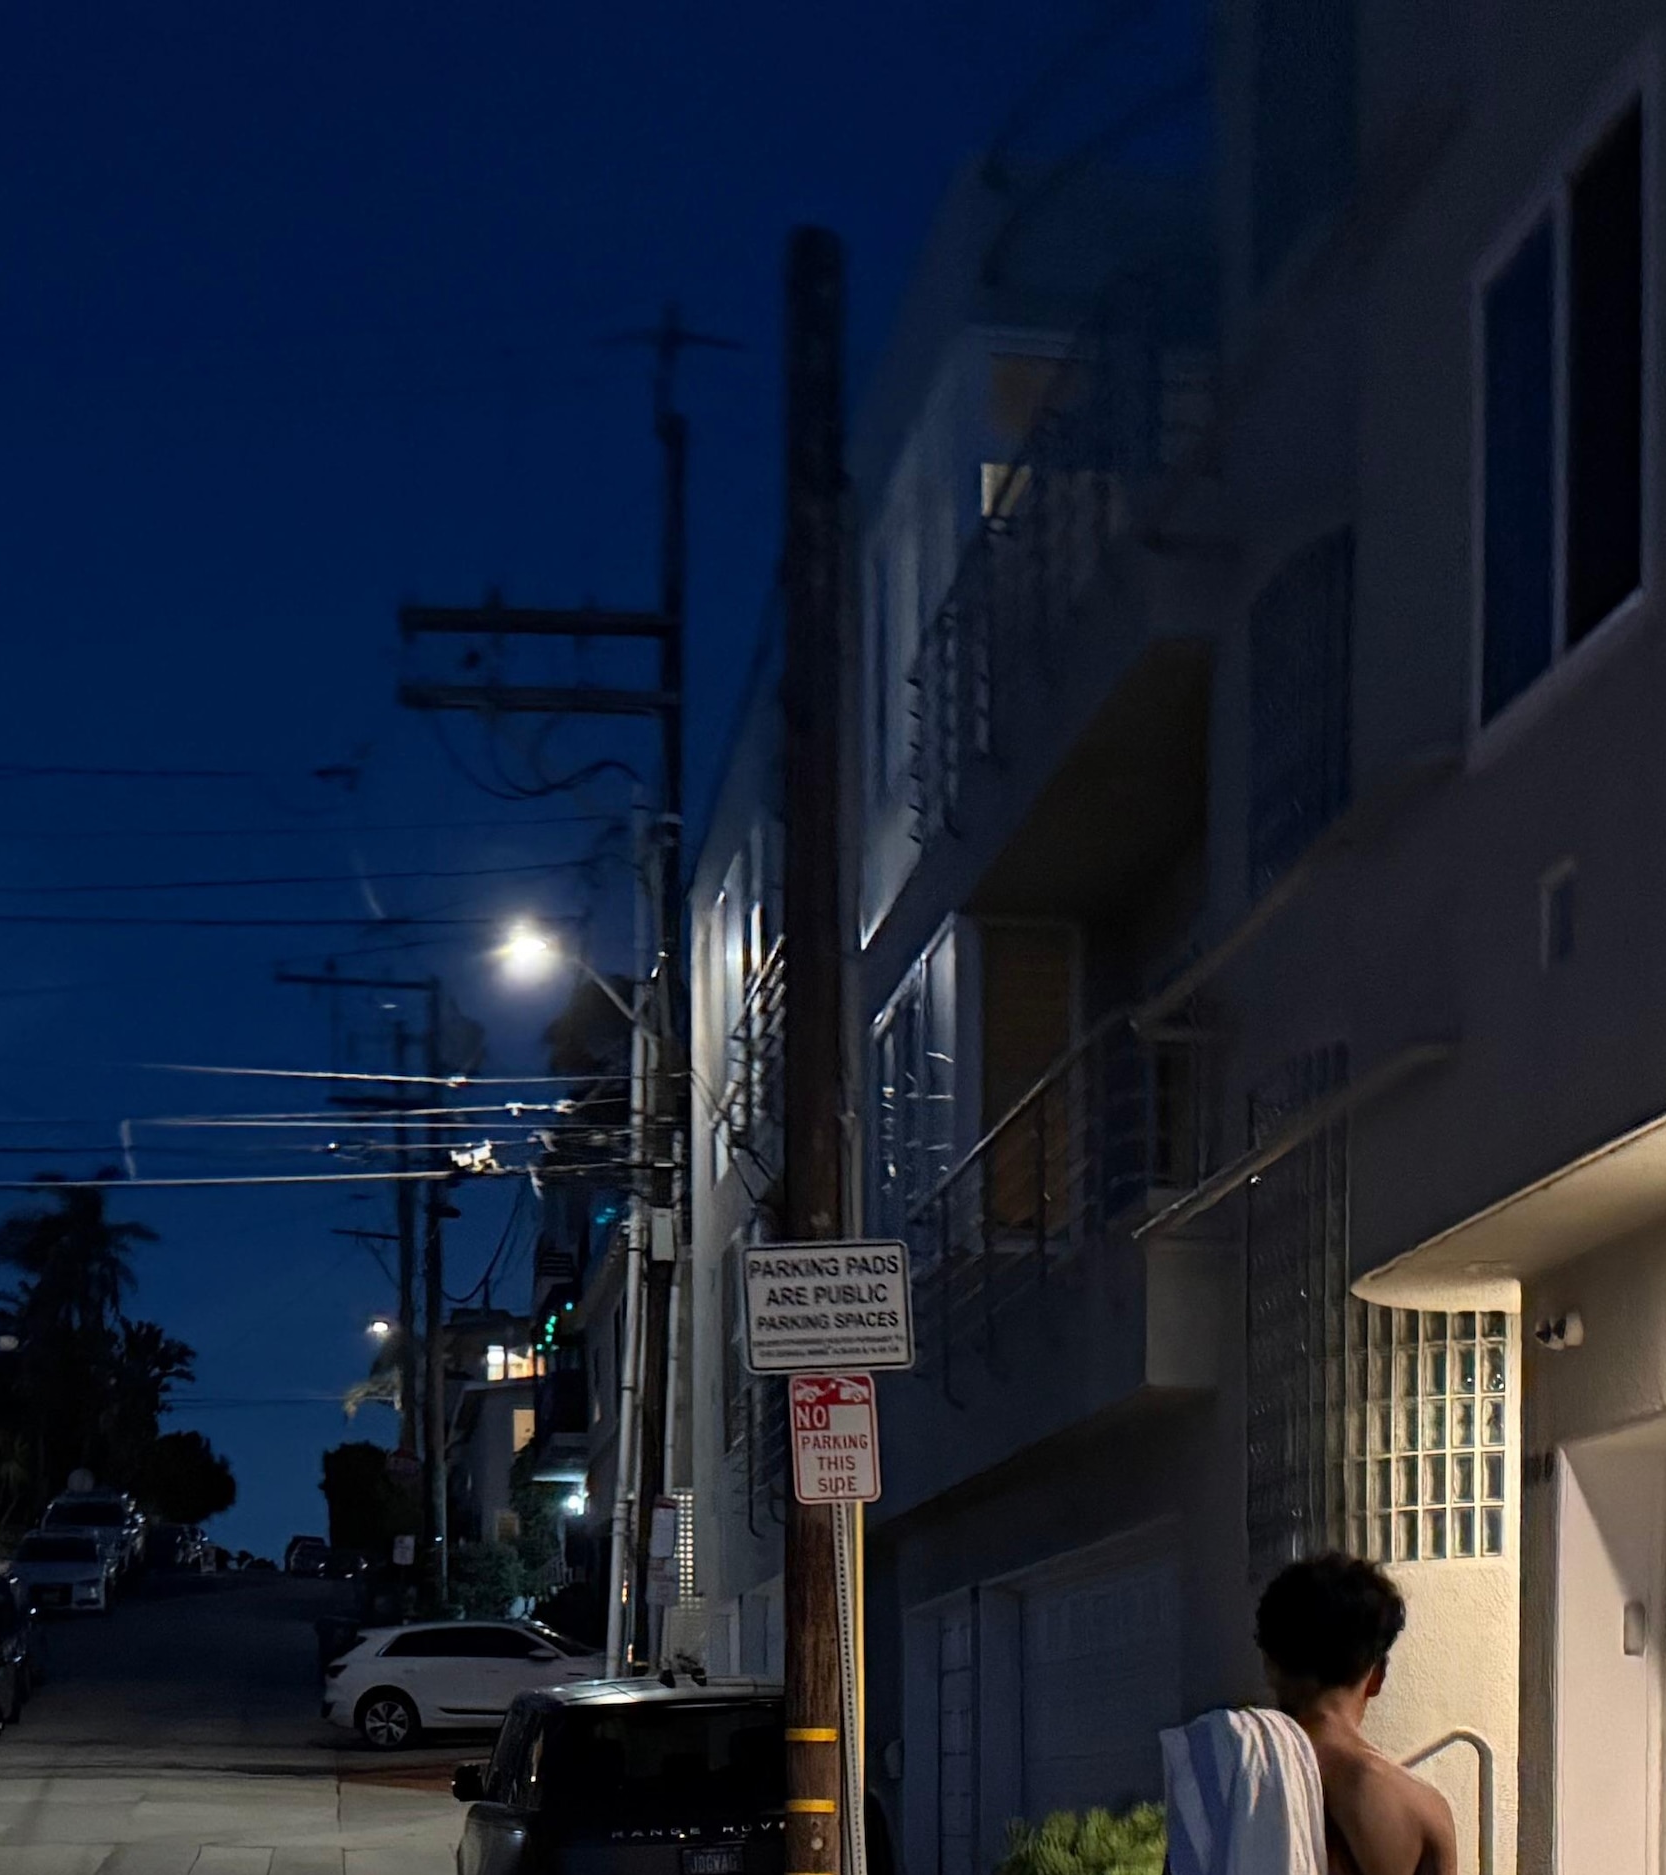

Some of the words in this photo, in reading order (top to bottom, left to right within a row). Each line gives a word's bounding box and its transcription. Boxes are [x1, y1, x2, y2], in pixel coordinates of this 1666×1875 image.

[749, 1258, 839, 1278] PARKING
[846, 1255, 899, 1275] PADS
[766, 1286, 809, 1306] ARE
[814, 1283, 887, 1304] PUBLIC
[757, 1314, 830, 1330] PARKING
[834, 1311, 899, 1328] SPACES
[796, 1405, 827, 1429] NO
[802, 1434, 868, 1450] PARKING
[817, 1454, 856, 1471] THIS
[818, 1475, 858, 1493] SIDE
[611, 1825, 700, 1841] RANGE
